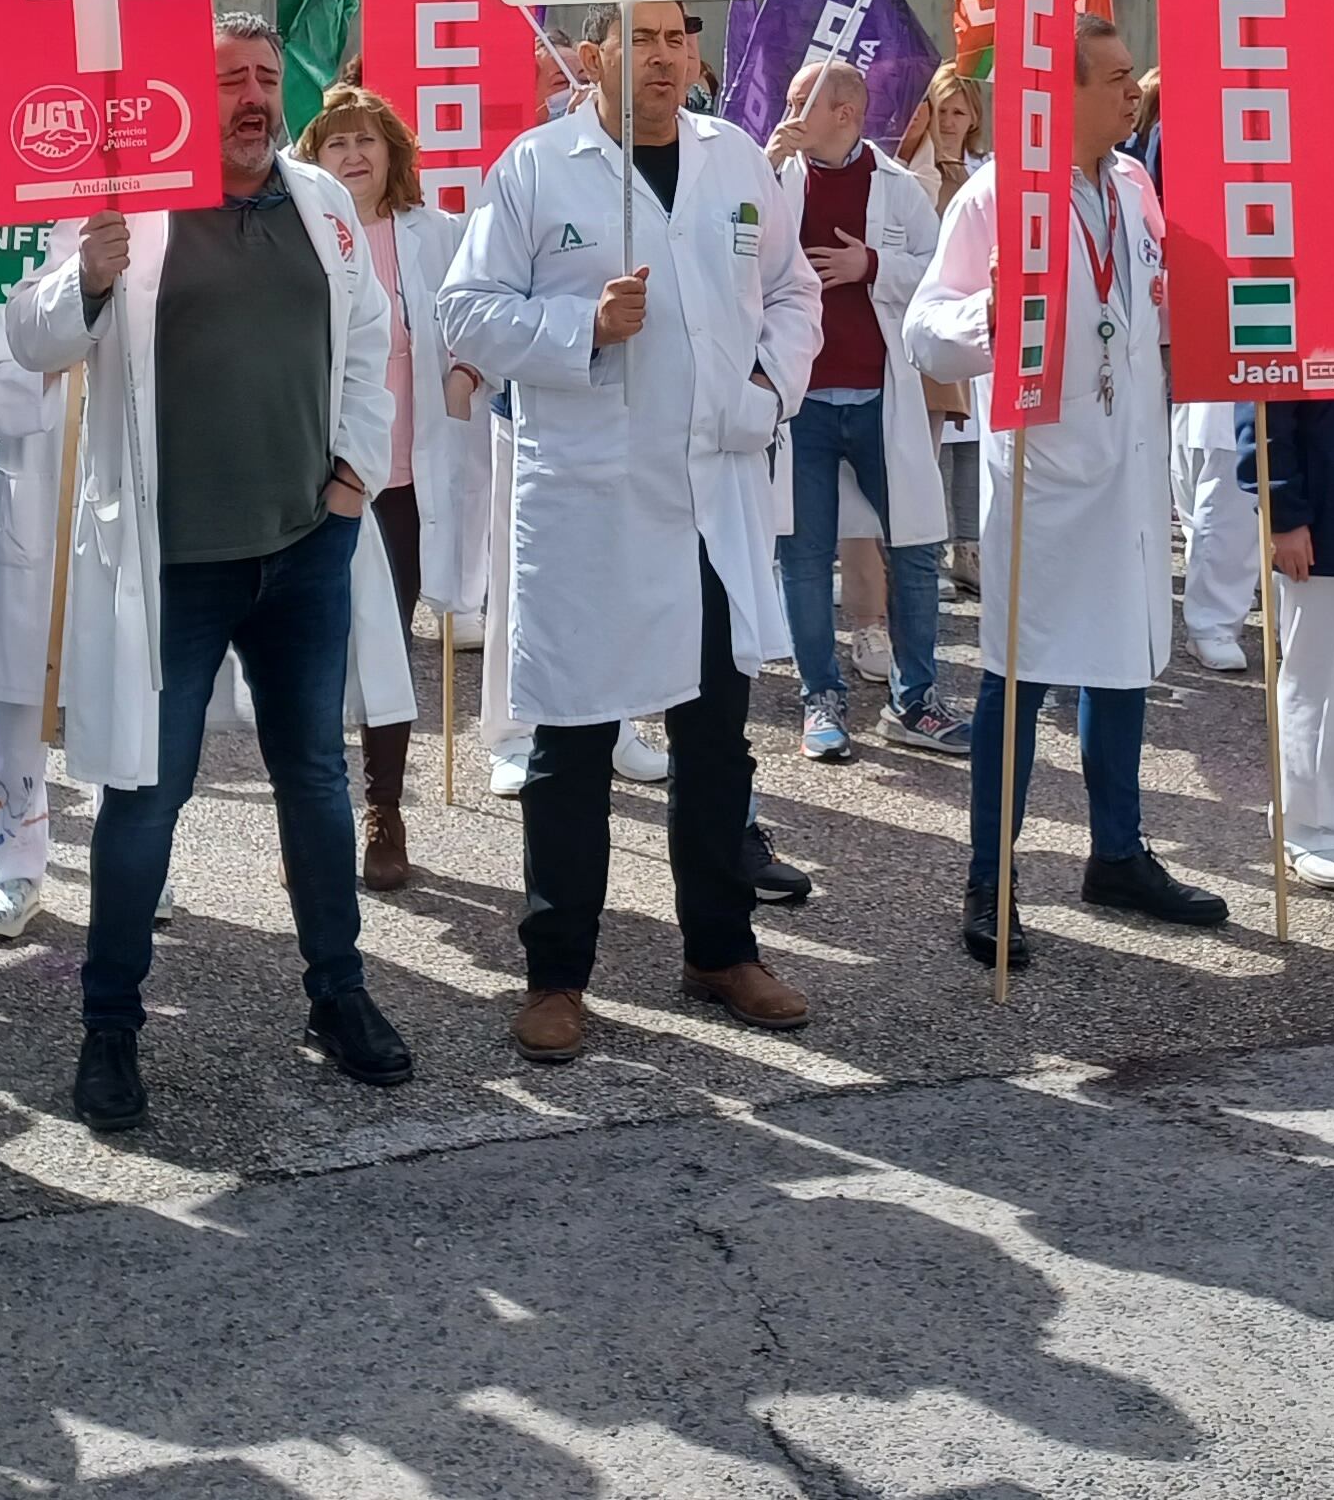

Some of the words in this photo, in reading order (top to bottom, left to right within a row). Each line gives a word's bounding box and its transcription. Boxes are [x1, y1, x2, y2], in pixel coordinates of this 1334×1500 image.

[24, 100, 85, 136] UGT
[106, 97, 152, 124] FSP
[107, 127, 147, 138] Servicios
[107, 137, 148, 149] Públicos
[72, 177, 141, 195] Andalucía
[1228, 359, 1299, 385] Jaén
[1014, 384, 1042, 411] Jaén
